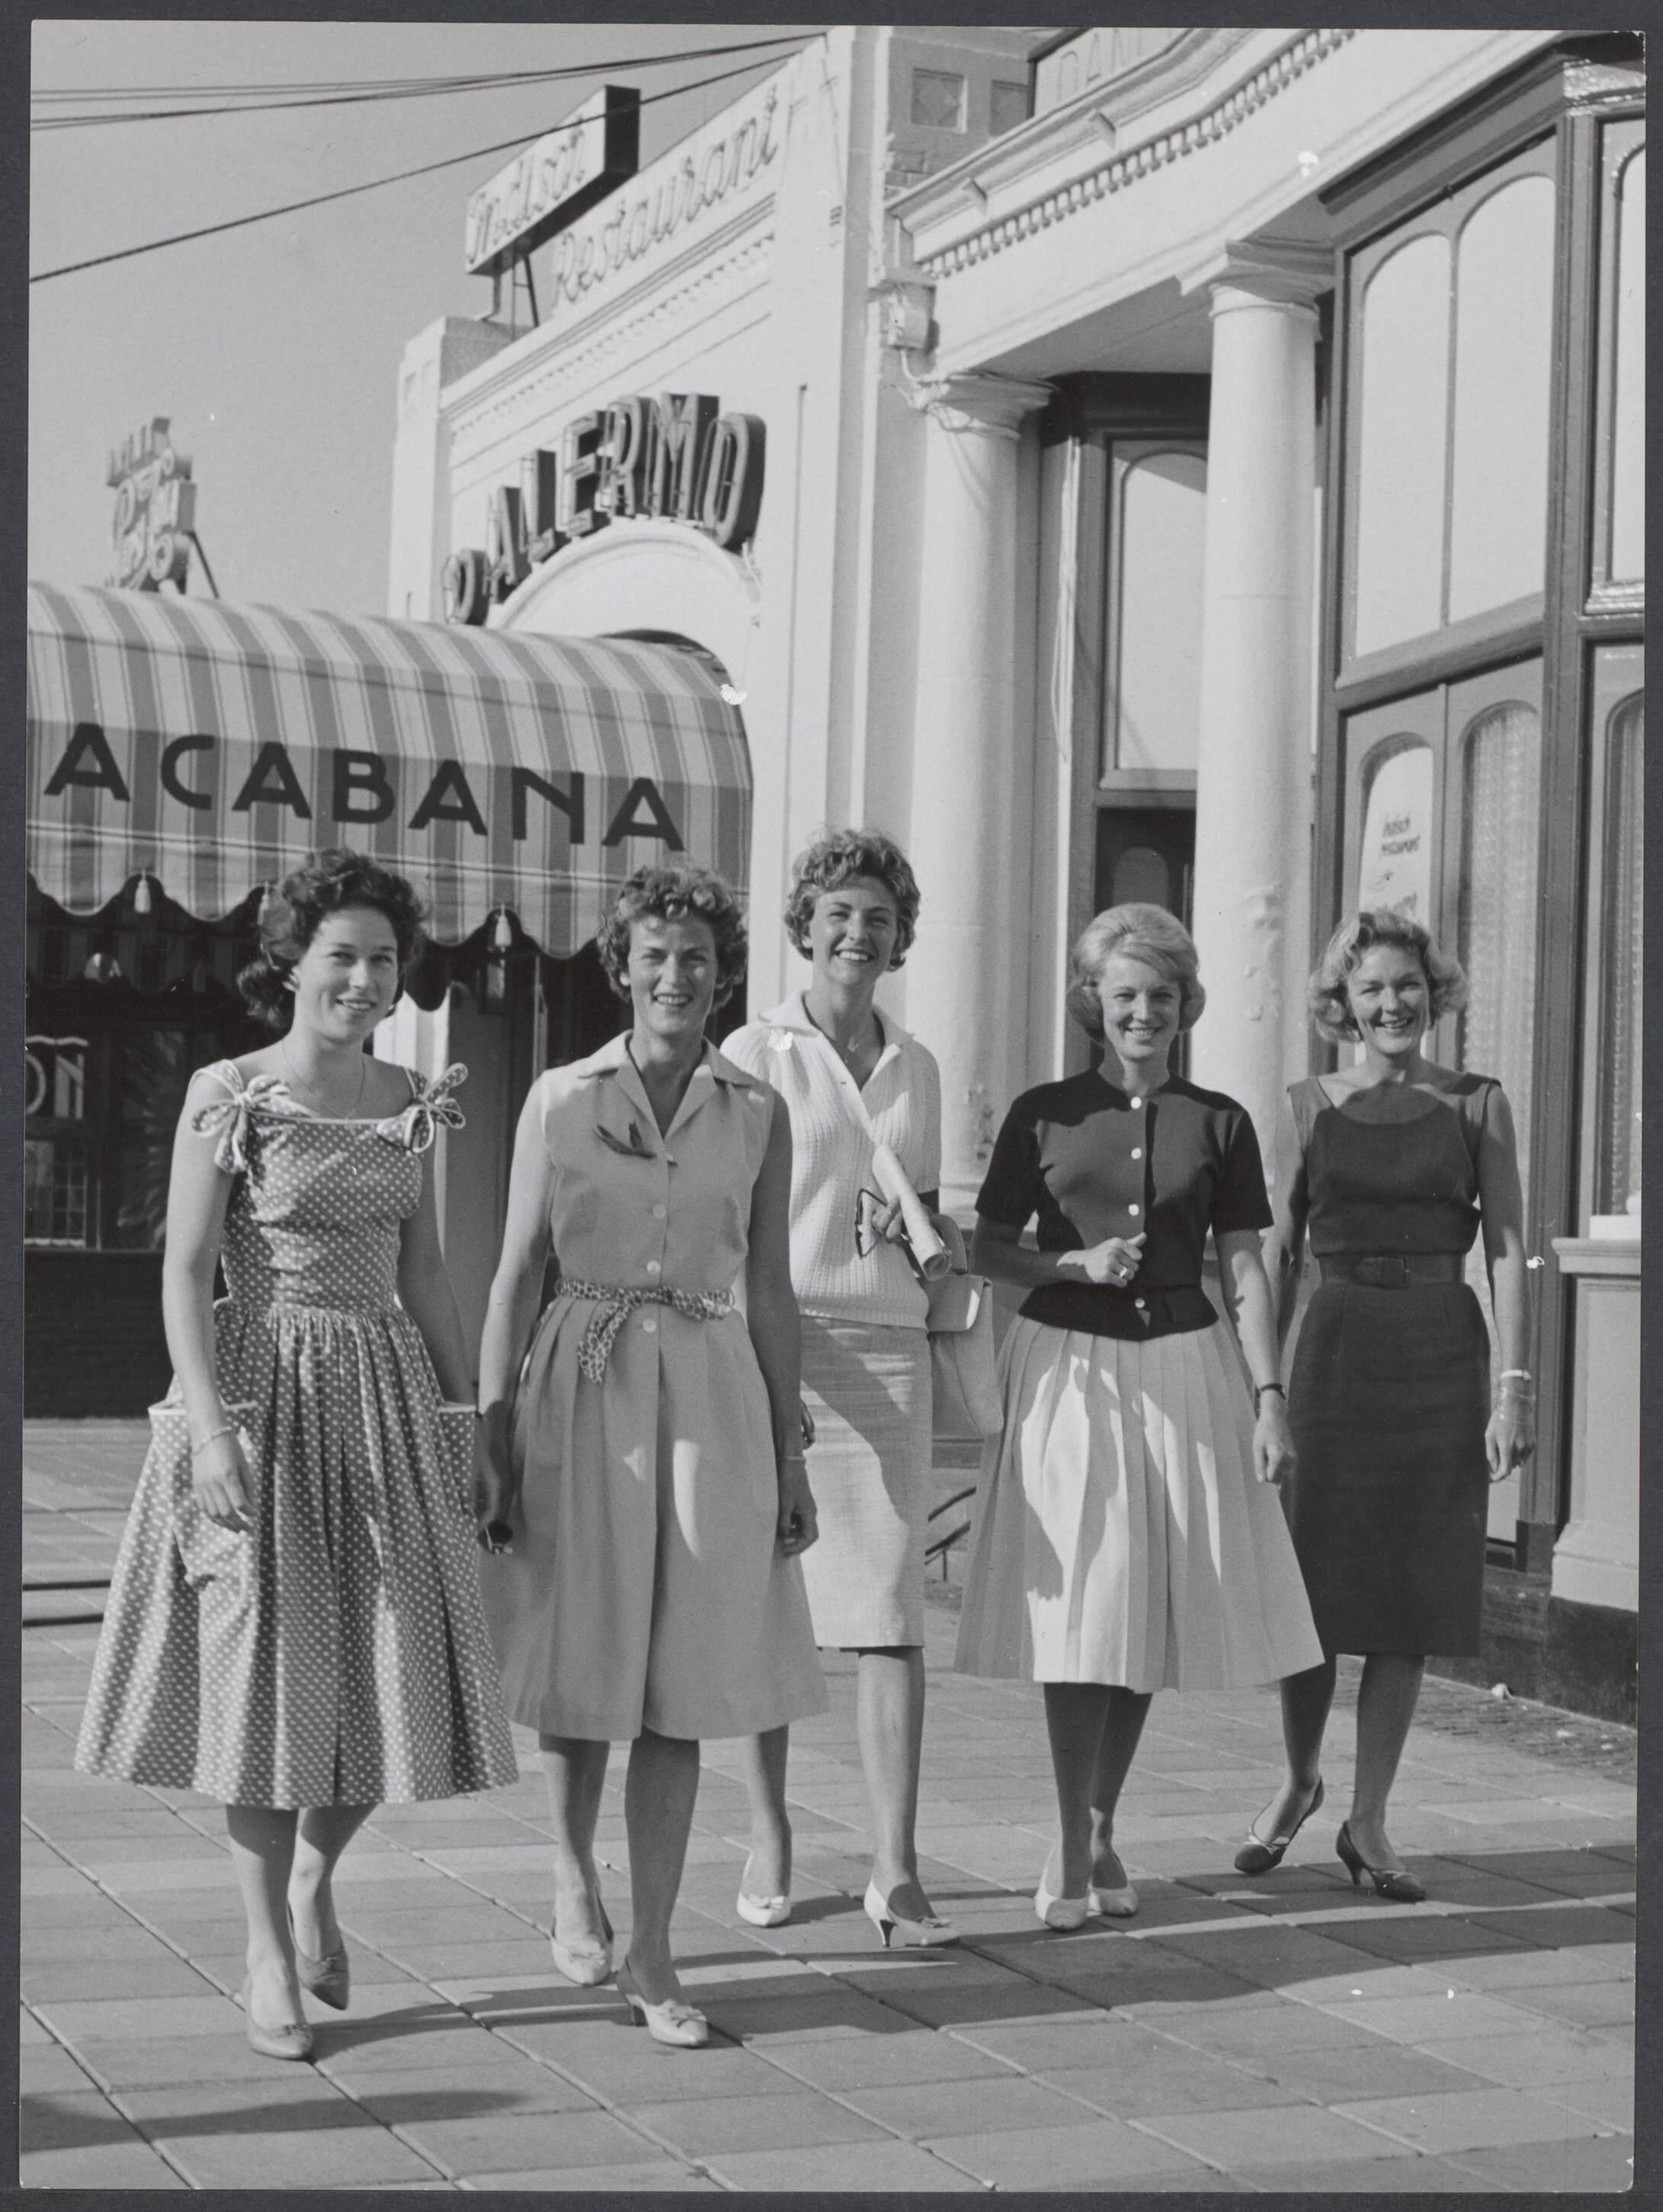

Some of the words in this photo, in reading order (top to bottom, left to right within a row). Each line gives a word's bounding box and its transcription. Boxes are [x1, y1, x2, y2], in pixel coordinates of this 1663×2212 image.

[550, 84, 777, 309] Restaurant
[441, 392, 766, 627] PALERMO
[43, 721, 685, 852] ACABANA
